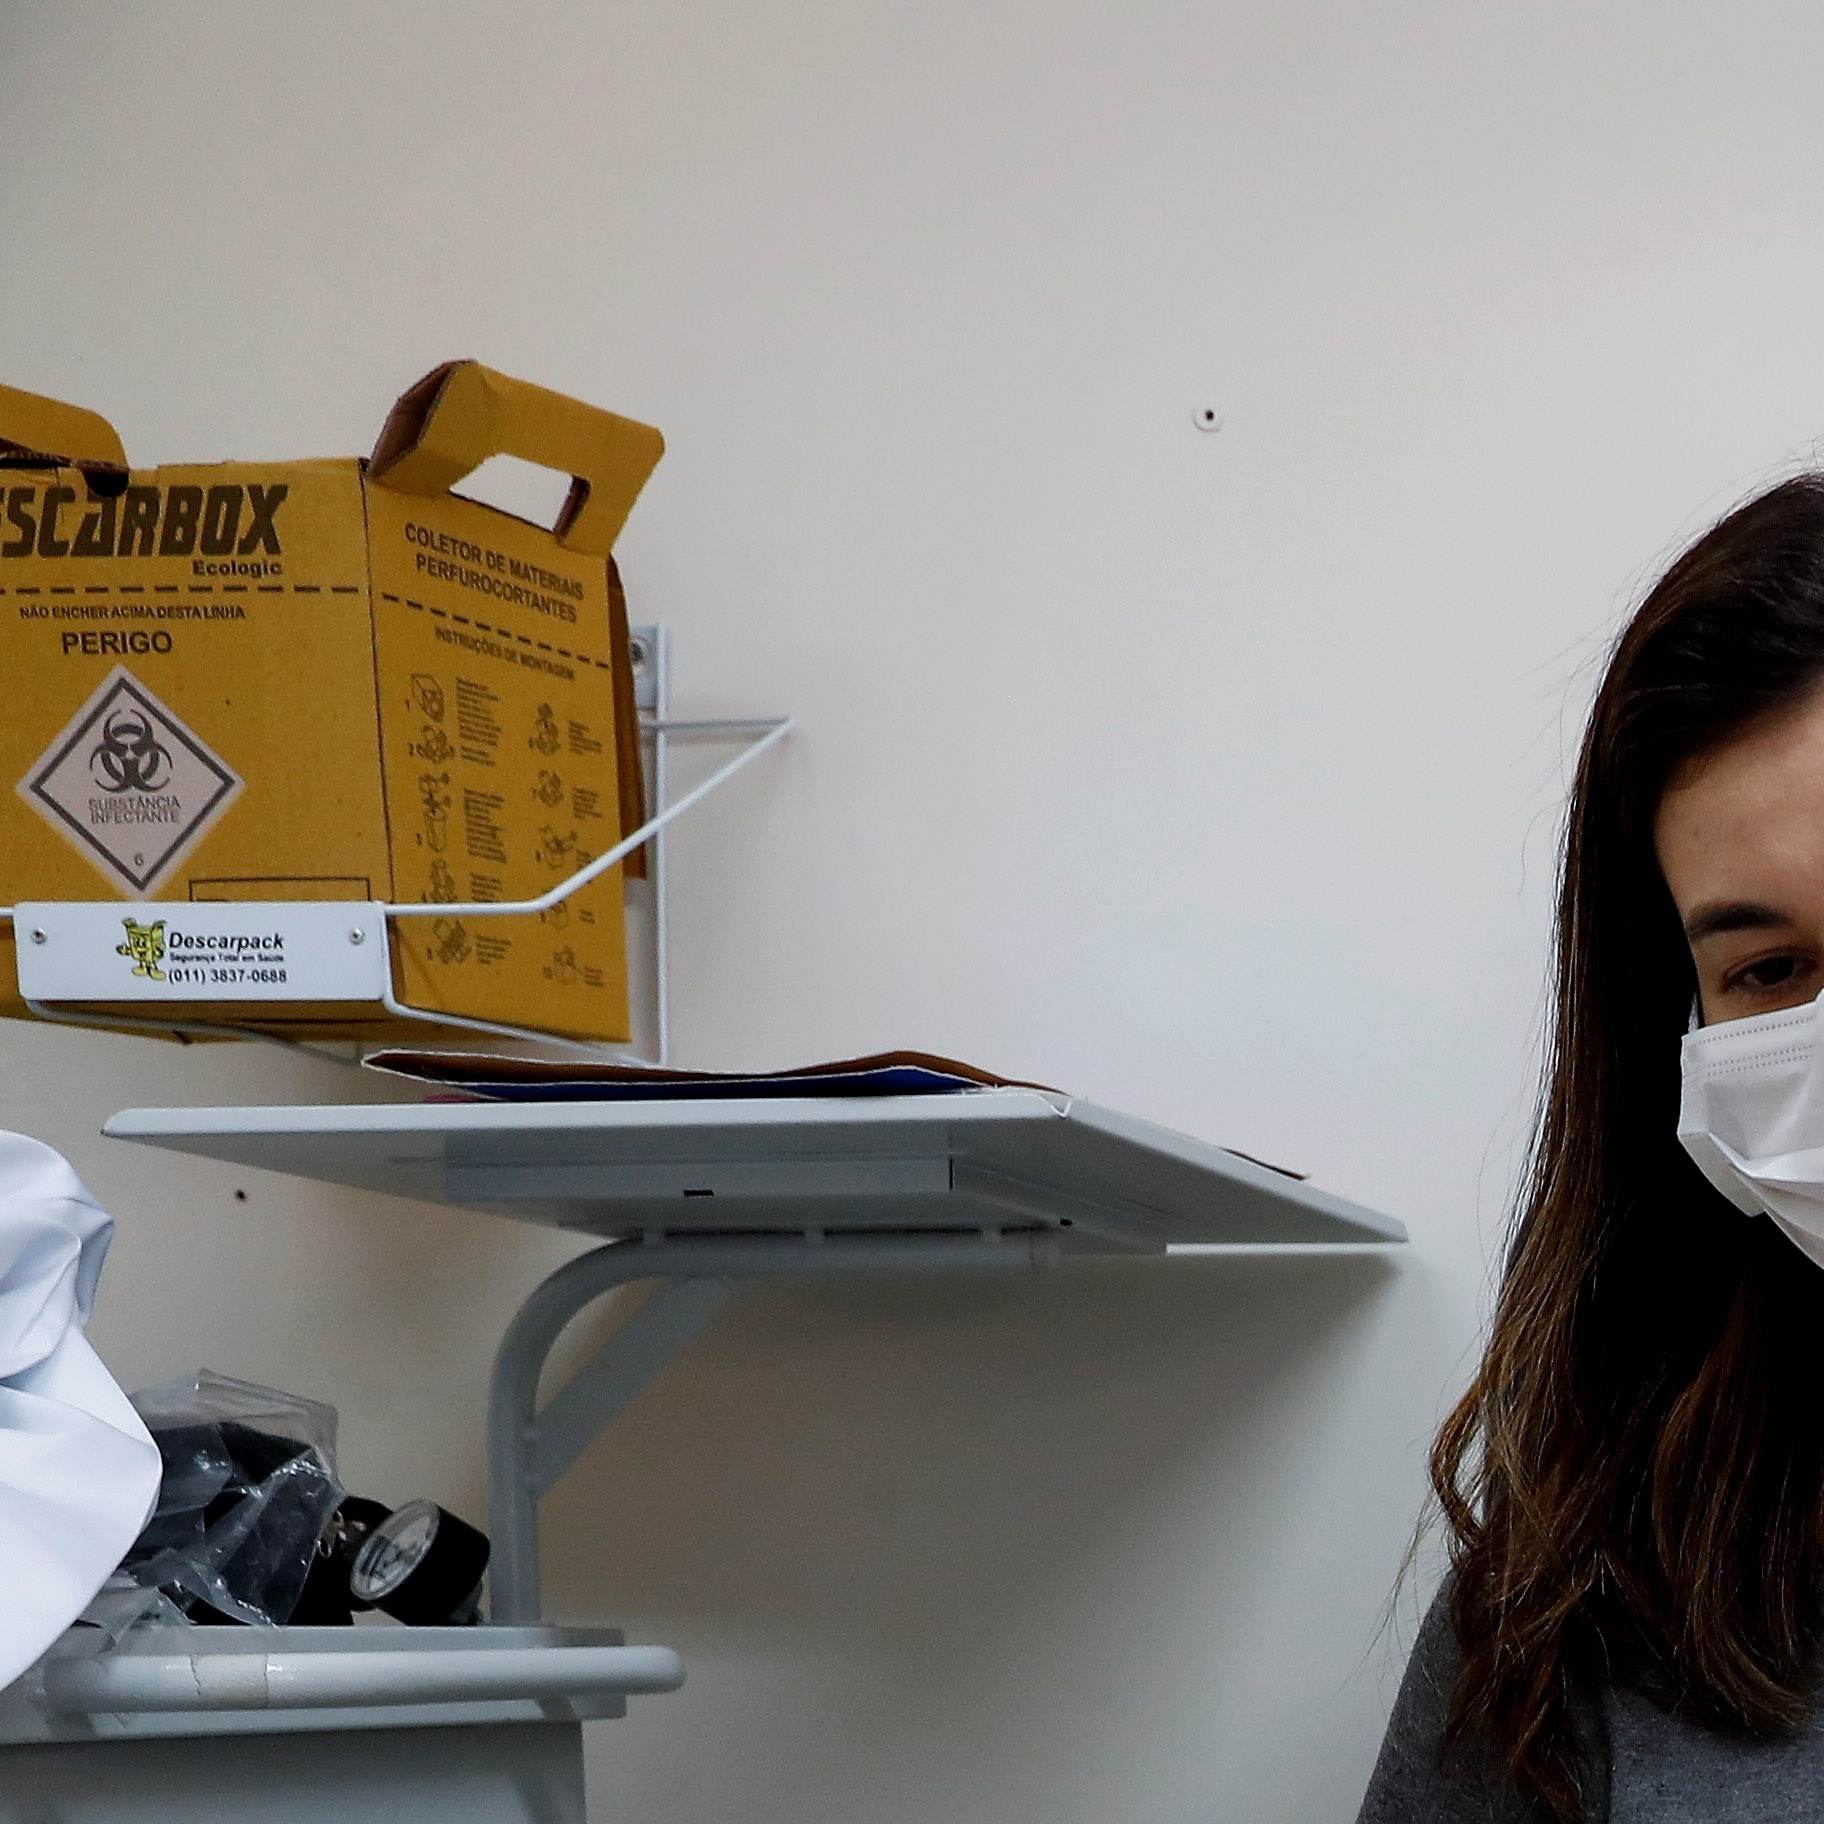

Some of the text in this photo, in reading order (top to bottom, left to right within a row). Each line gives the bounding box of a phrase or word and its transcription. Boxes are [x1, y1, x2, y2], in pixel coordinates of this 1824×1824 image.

[0, 485, 289, 557] SCARBOX
[193, 559, 282, 580] Ecologic
[404, 522, 585, 600] COLETOR DE MATERIAIS
[416, 552, 577, 624] PERFUROCORTANTES
[19, 603, 247, 620] NÃO ENCHER ACIMA DESTA LINHA
[61, 631, 174, 655] PERIGO
[88, 795, 182, 811] SUBSTÂNCIA
[90, 810, 180, 824] INFECTANTE
[133, 852, 145, 867] 6
[168, 931, 285, 953] Descarpack
[168, 967, 288, 984] (011) 3837-0688
